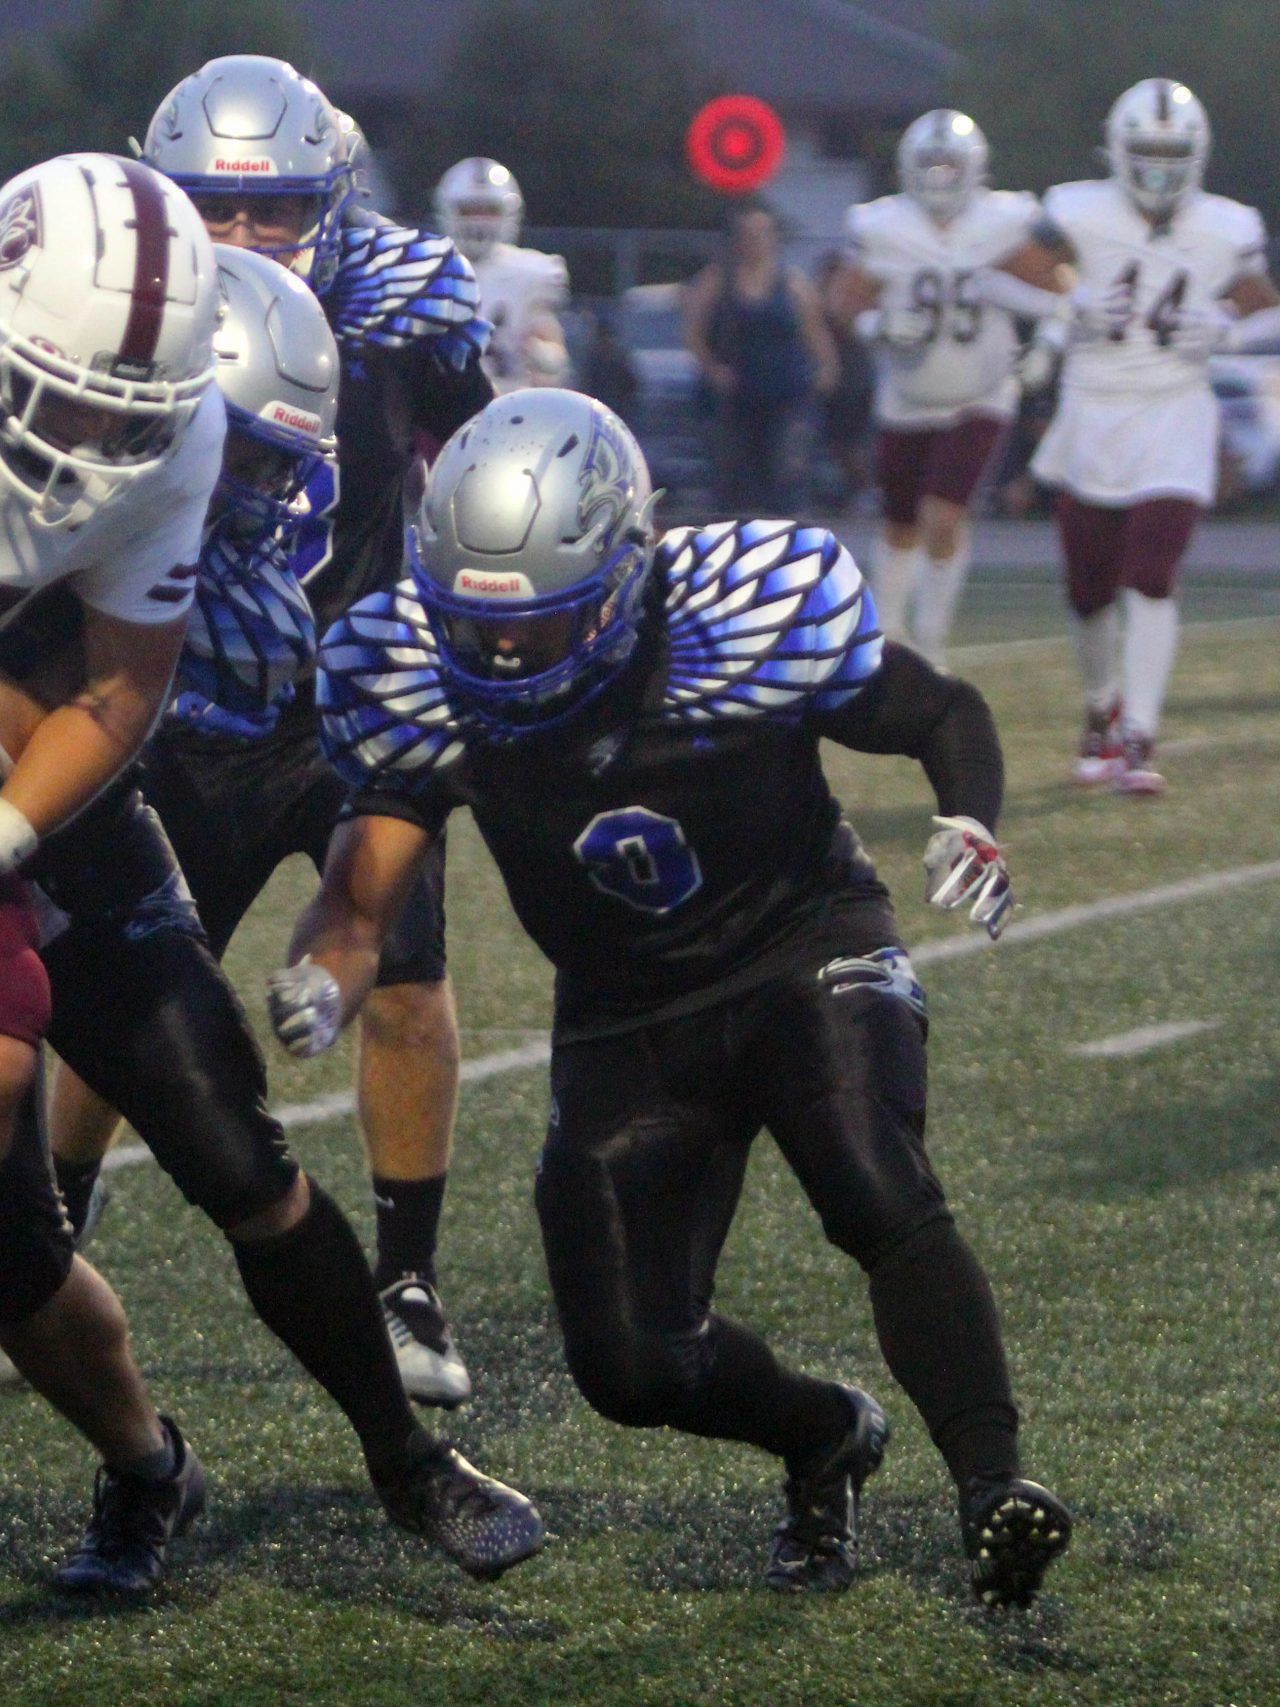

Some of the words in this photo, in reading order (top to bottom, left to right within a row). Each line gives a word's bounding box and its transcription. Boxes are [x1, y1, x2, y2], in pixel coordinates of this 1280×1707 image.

[214, 158, 271, 172] Riddell
[273, 406, 320, 434] Riddell
[461, 575, 521, 593] Riddell
